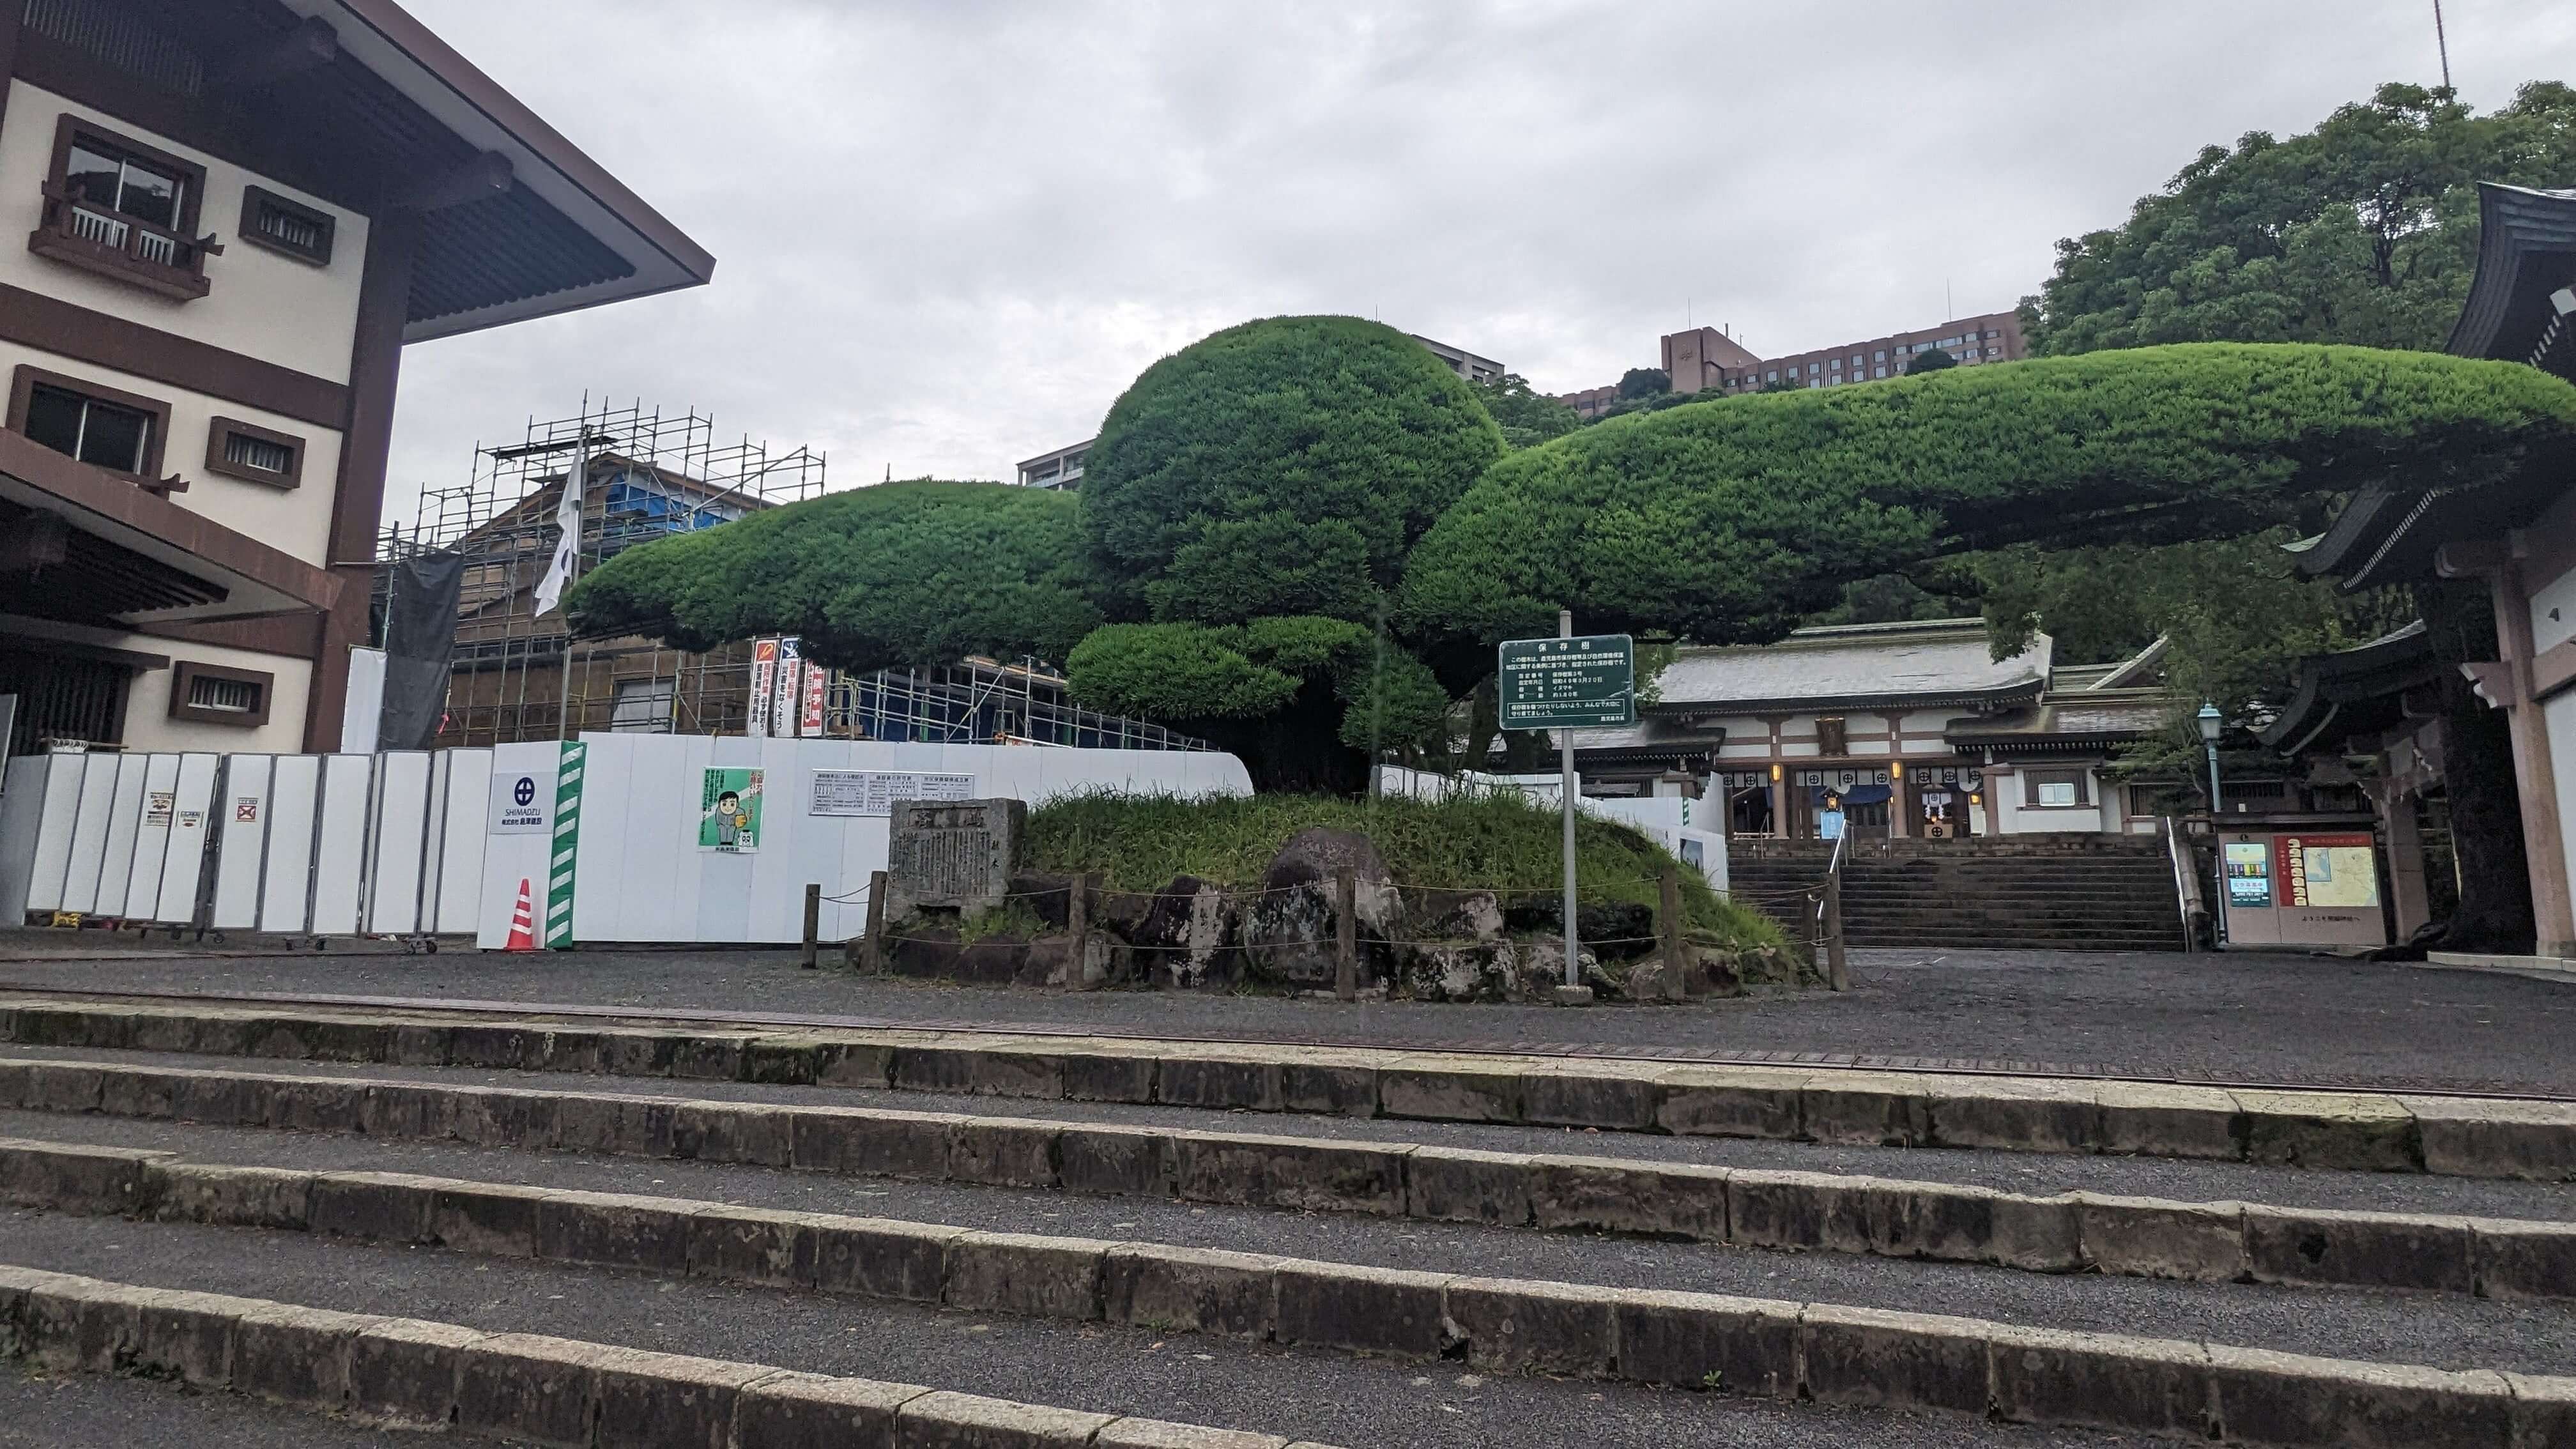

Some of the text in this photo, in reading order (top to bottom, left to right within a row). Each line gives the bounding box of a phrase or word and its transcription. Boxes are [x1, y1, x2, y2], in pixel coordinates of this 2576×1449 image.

[1538, 641, 1590, 652] 保存樹
[776, 667, 788, 729] 災害をなくそう
